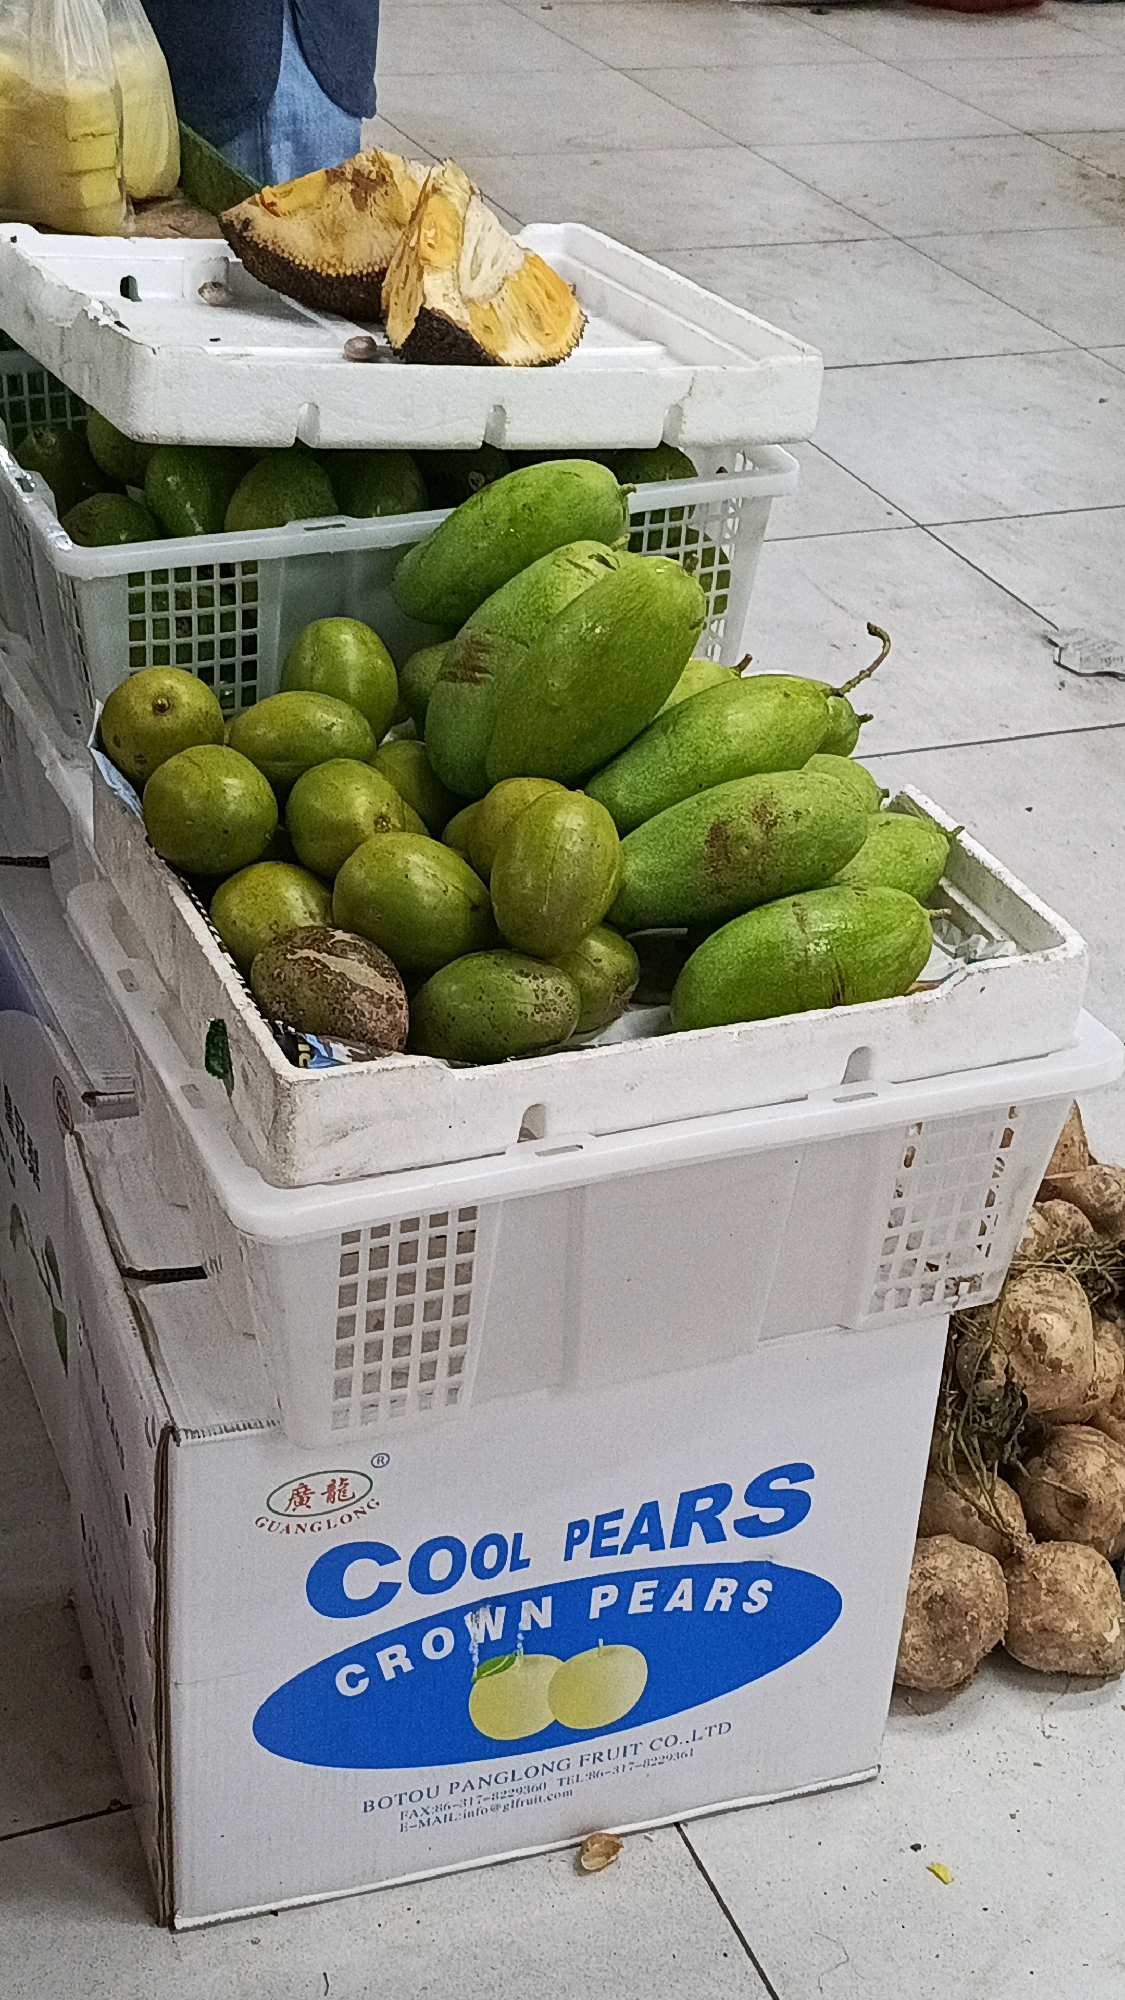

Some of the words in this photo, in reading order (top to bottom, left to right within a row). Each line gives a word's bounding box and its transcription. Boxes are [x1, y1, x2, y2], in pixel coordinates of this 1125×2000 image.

[254, 1497, 380, 1535] GUANGLONG
[306, 1532, 531, 1618] COOL
[563, 1462, 815, 1562] PEARS
[335, 1595, 553, 1698] CROWN
[589, 1577, 773, 1619] PEARS
[363, 1785, 440, 1813] BOTOU
[449, 1757, 571, 1795] PANGLONG
[579, 1741, 643, 1768] FRUIT
